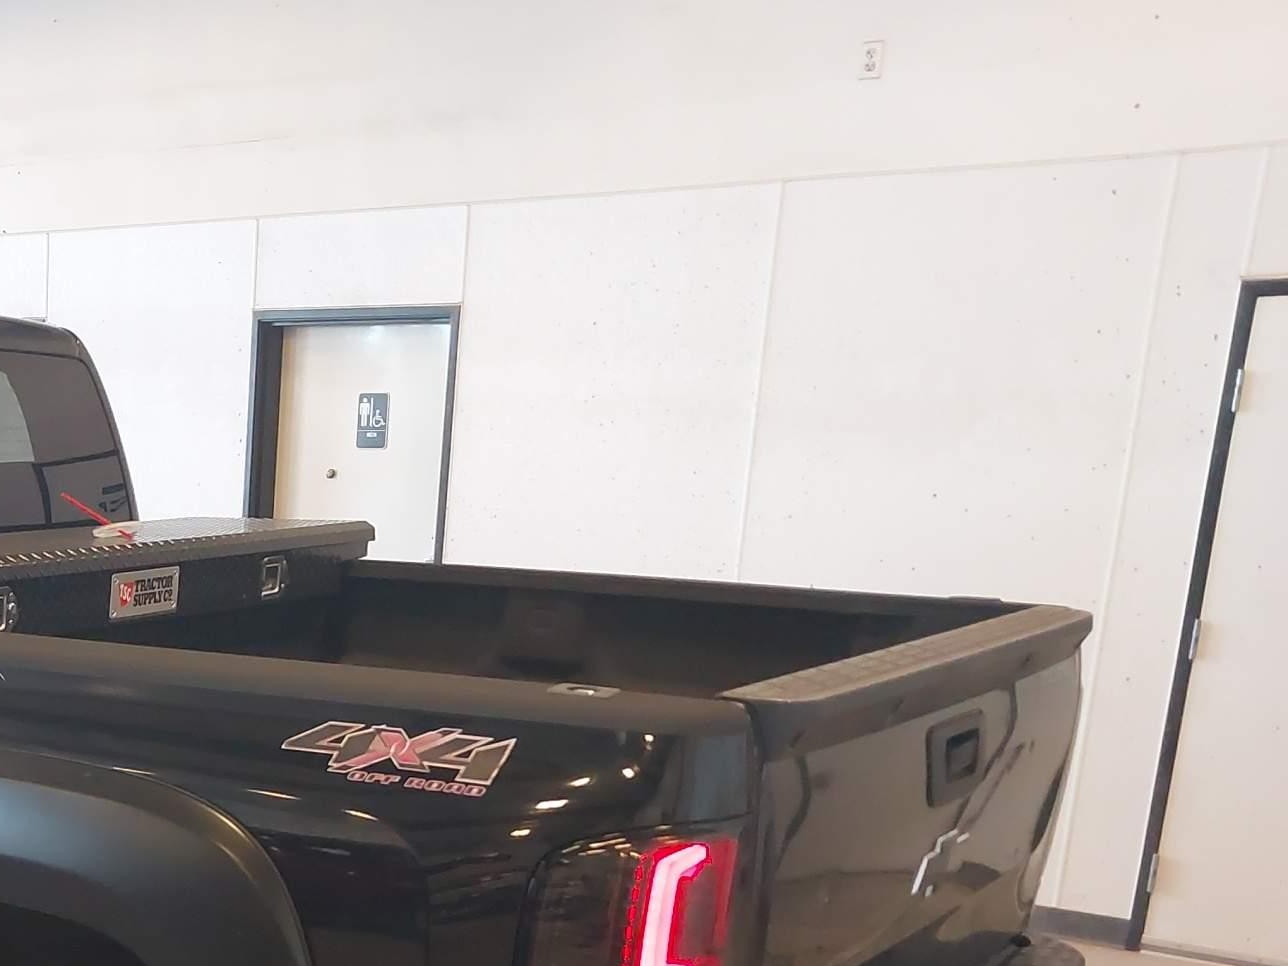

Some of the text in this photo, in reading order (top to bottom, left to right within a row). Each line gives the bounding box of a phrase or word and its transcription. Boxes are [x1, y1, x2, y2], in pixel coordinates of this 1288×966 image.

[119, 583, 132, 603] TSC
[134, 576, 173, 593] TRACTOR
[132, 589, 163, 608] SUPPLY
[346, 771, 487, 797] OFF ROAD
